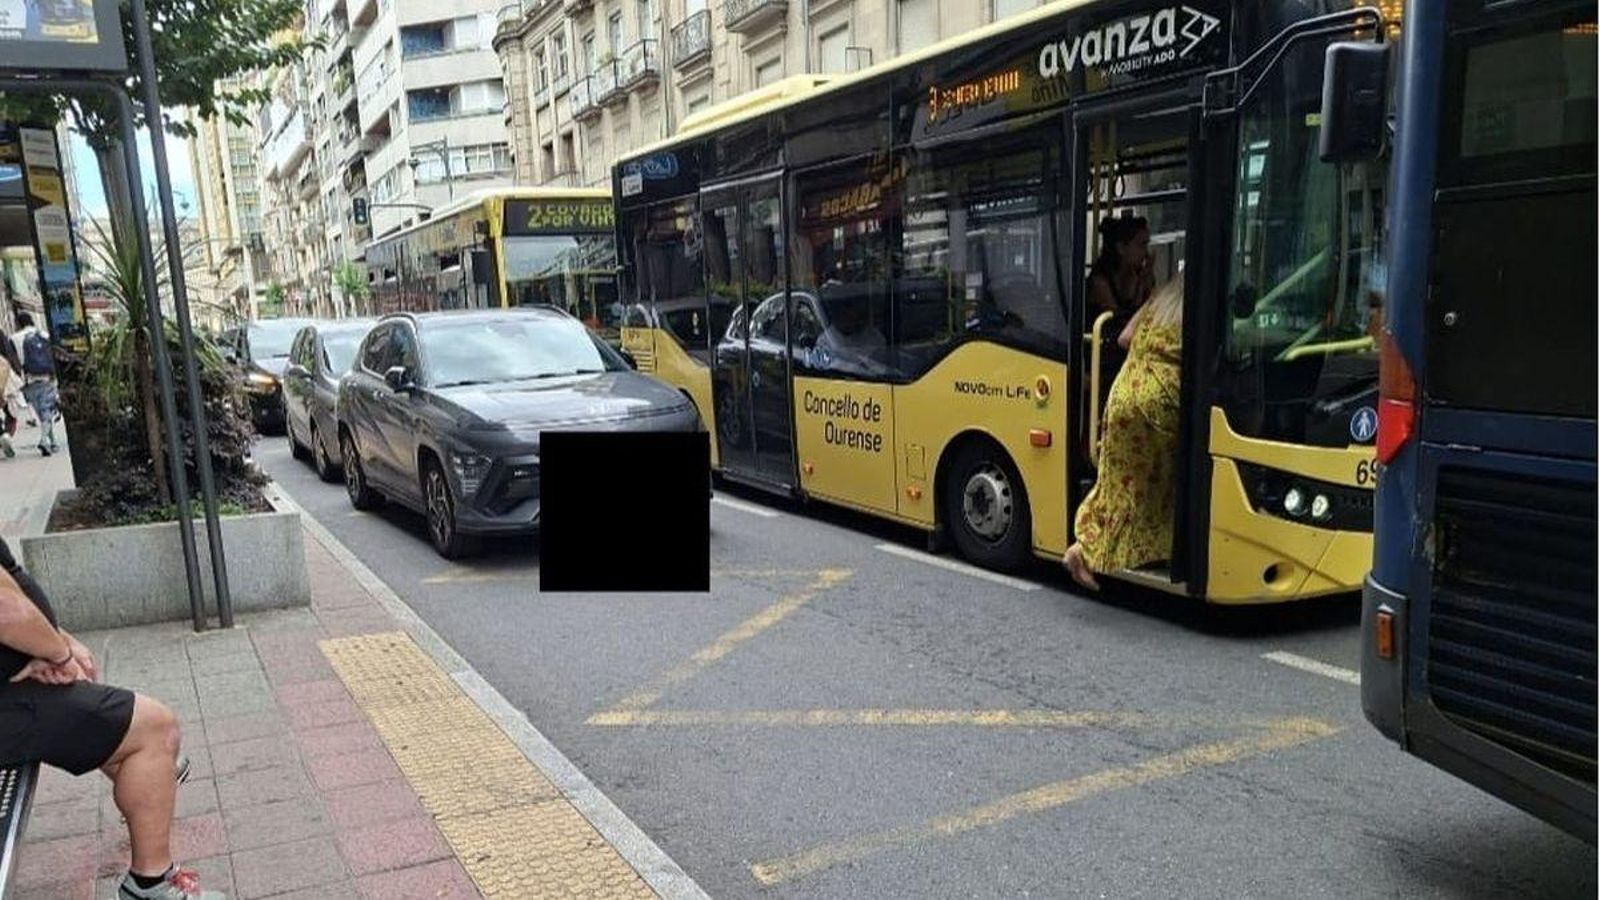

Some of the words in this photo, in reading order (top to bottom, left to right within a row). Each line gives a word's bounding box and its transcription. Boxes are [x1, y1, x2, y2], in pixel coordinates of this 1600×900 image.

[1039, 7, 1177, 78] avanza
[1109, 56, 1154, 75] MOBILITY
[1154, 48, 1176, 64] ADO
[527, 205, 542, 228] 2
[546, 204, 612, 215] COVADO
[804, 390, 859, 418] Concello
[863, 397, 881, 422] de
[824, 422, 882, 452] Ourense
